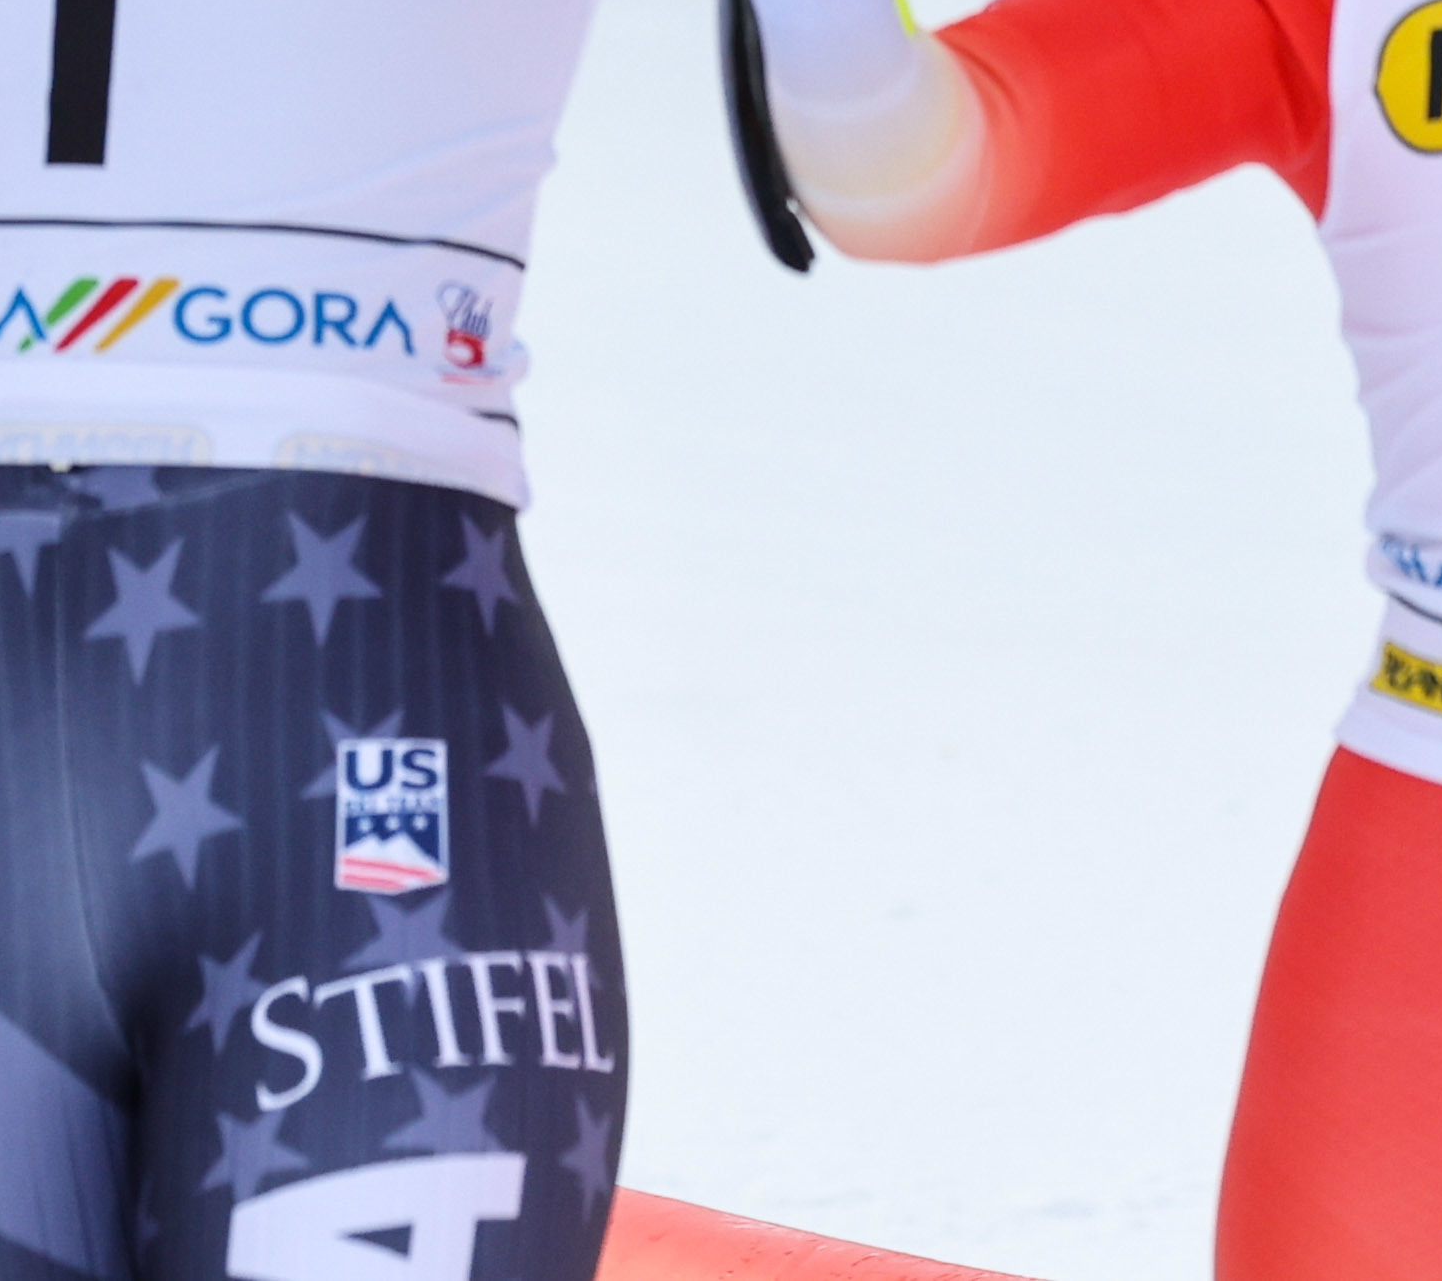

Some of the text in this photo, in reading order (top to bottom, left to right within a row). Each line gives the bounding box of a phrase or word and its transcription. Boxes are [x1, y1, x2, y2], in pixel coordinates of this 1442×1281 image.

[172, 285, 415, 356] GORA
[345, 749, 438, 791] US
[250, 949, 615, 1112] STIFEL
